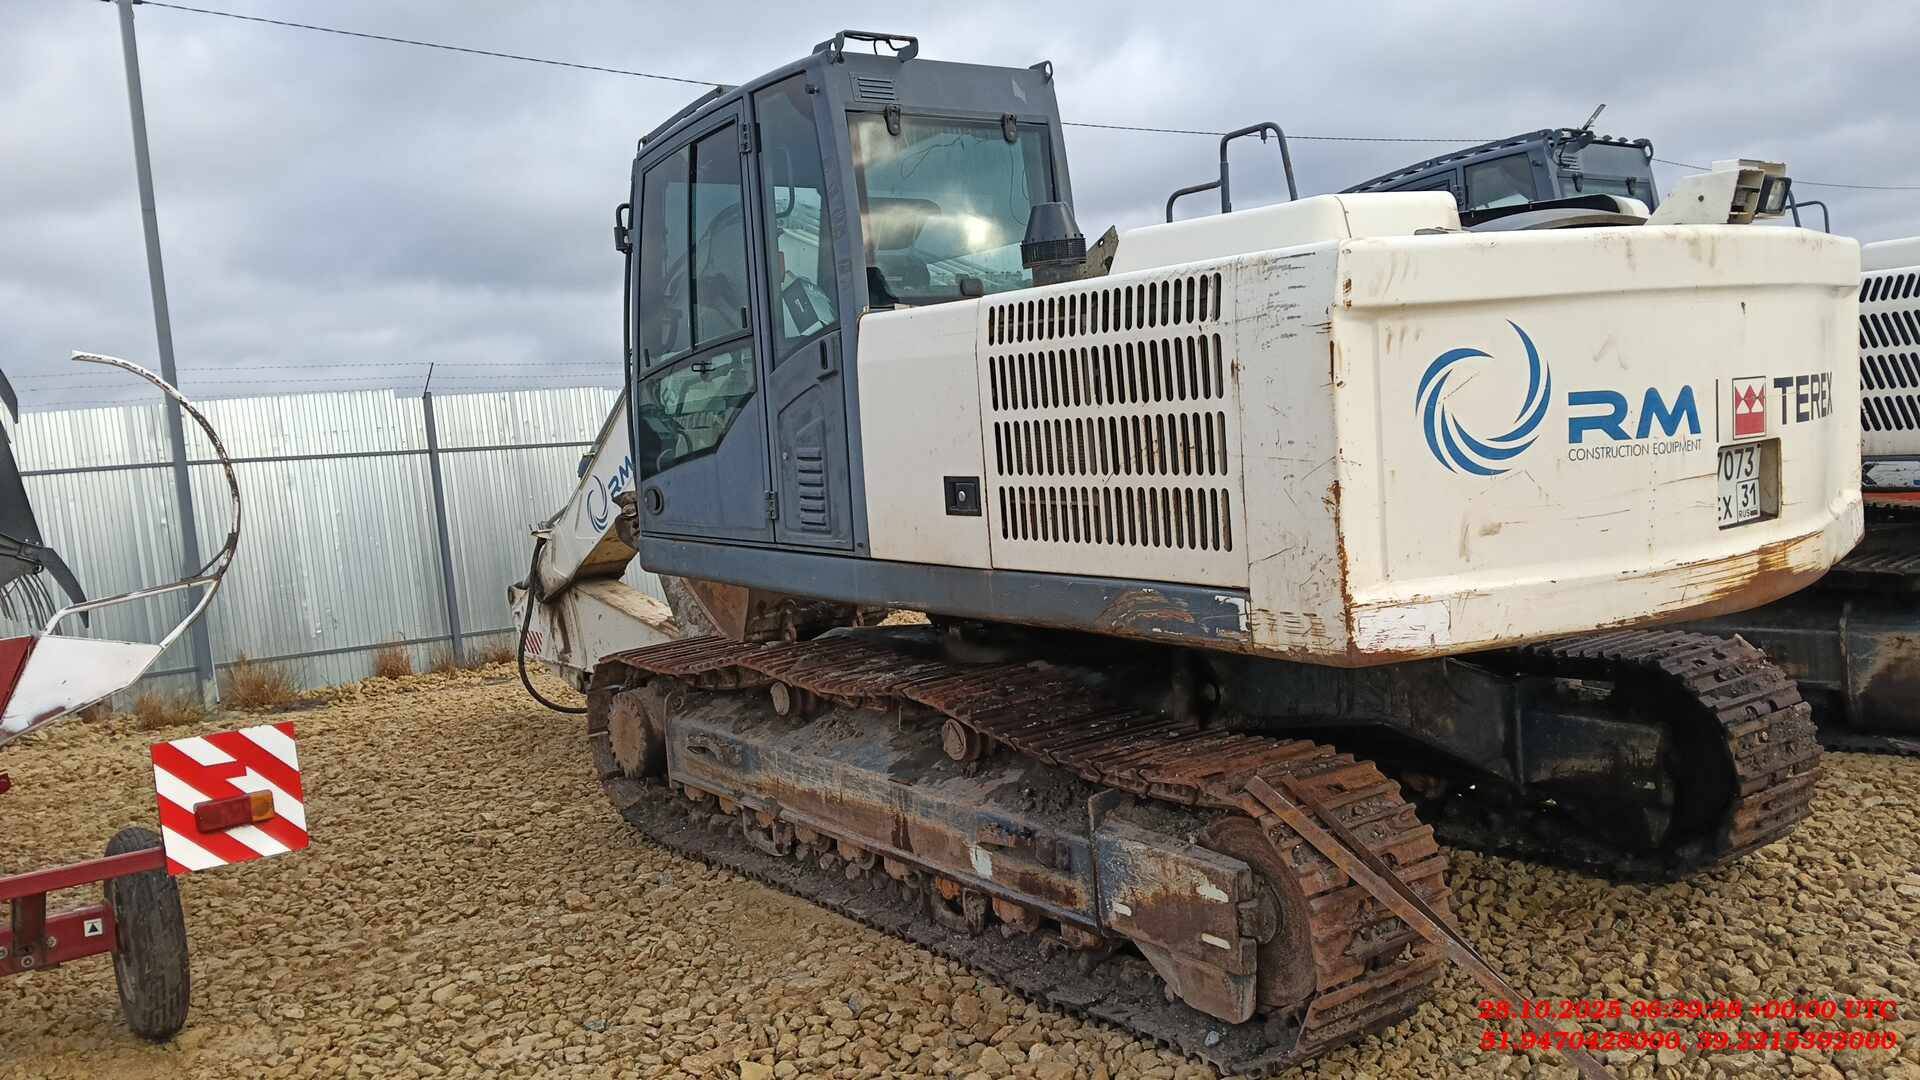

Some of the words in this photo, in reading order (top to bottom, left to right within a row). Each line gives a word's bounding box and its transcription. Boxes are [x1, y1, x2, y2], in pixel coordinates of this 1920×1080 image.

[1568, 385, 1702, 444] RM
[1774, 371, 1833, 425] TEREX
[1568, 443, 1649, 462] CONSTRUCTION
[1653, 439, 1702, 456] EQUIPMENT
[1741, 483, 1756, 507] 31
